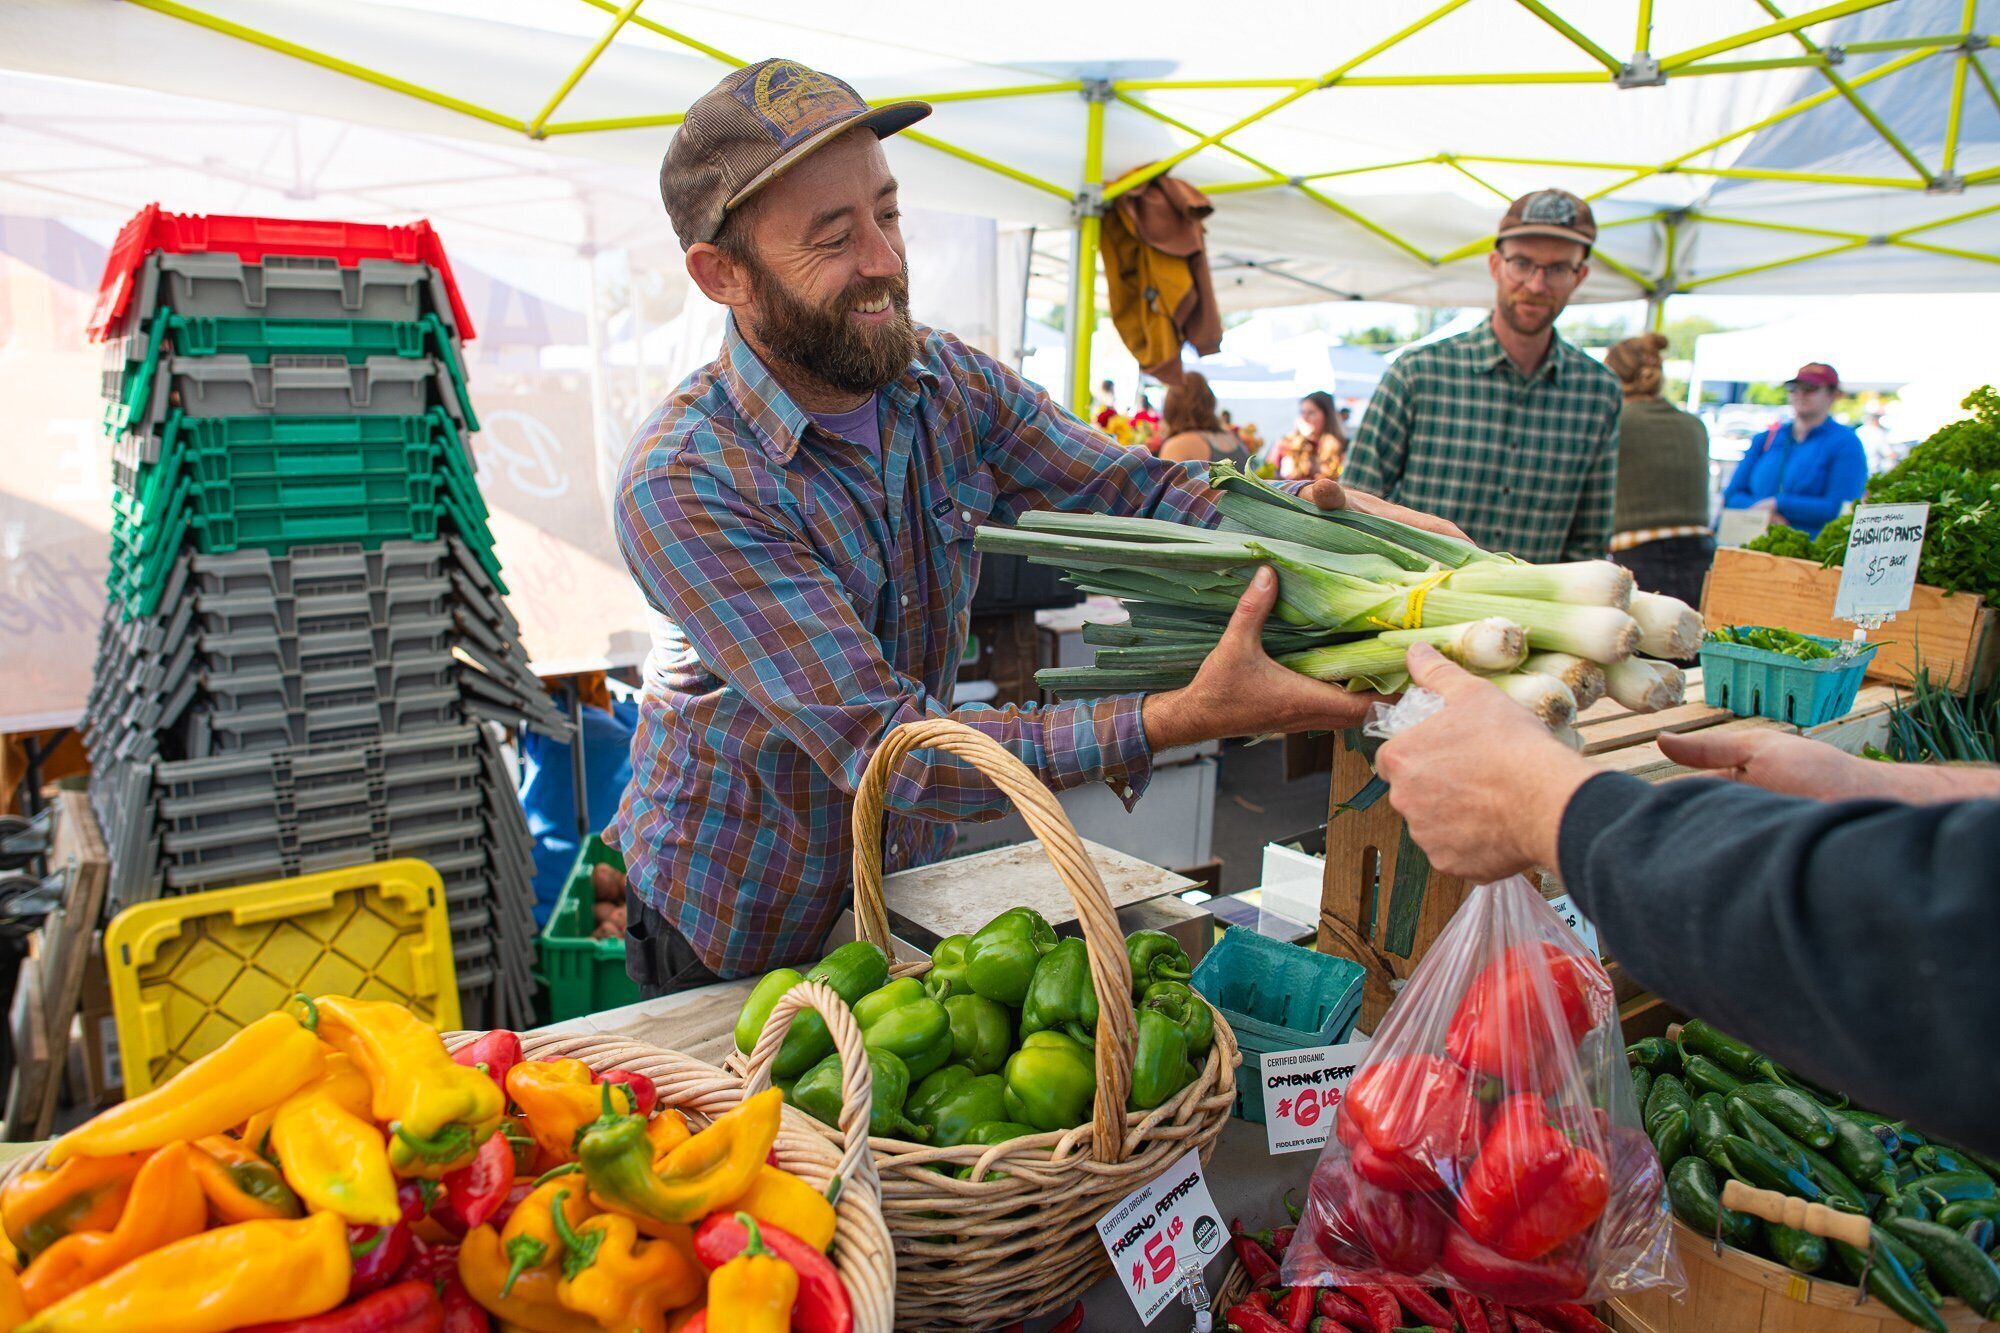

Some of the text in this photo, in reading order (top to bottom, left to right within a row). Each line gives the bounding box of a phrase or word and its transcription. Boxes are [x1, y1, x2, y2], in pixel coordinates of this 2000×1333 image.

[1866, 555, 1888, 586] $5
[1267, 1052, 1325, 1067] CERTIFIED ORGANIC
[1267, 1070, 1322, 1089] CAYENNE
[1321, 1087, 1343, 1108] LB
[1275, 1139, 1305, 1149] FIDDLER'S
[1305, 1136, 1326, 1145] GREEN
[1102, 1186, 1154, 1236] CERTIFIED ORGANIC
[1111, 1171, 1200, 1258] FRESNO PEPPERS
[1166, 1215, 1184, 1242] LB
[1195, 1221, 1212, 1239] USDA
[1200, 1228, 1218, 1250] ORGANIC
[1145, 1291, 1170, 1319] FIDDLER'S
